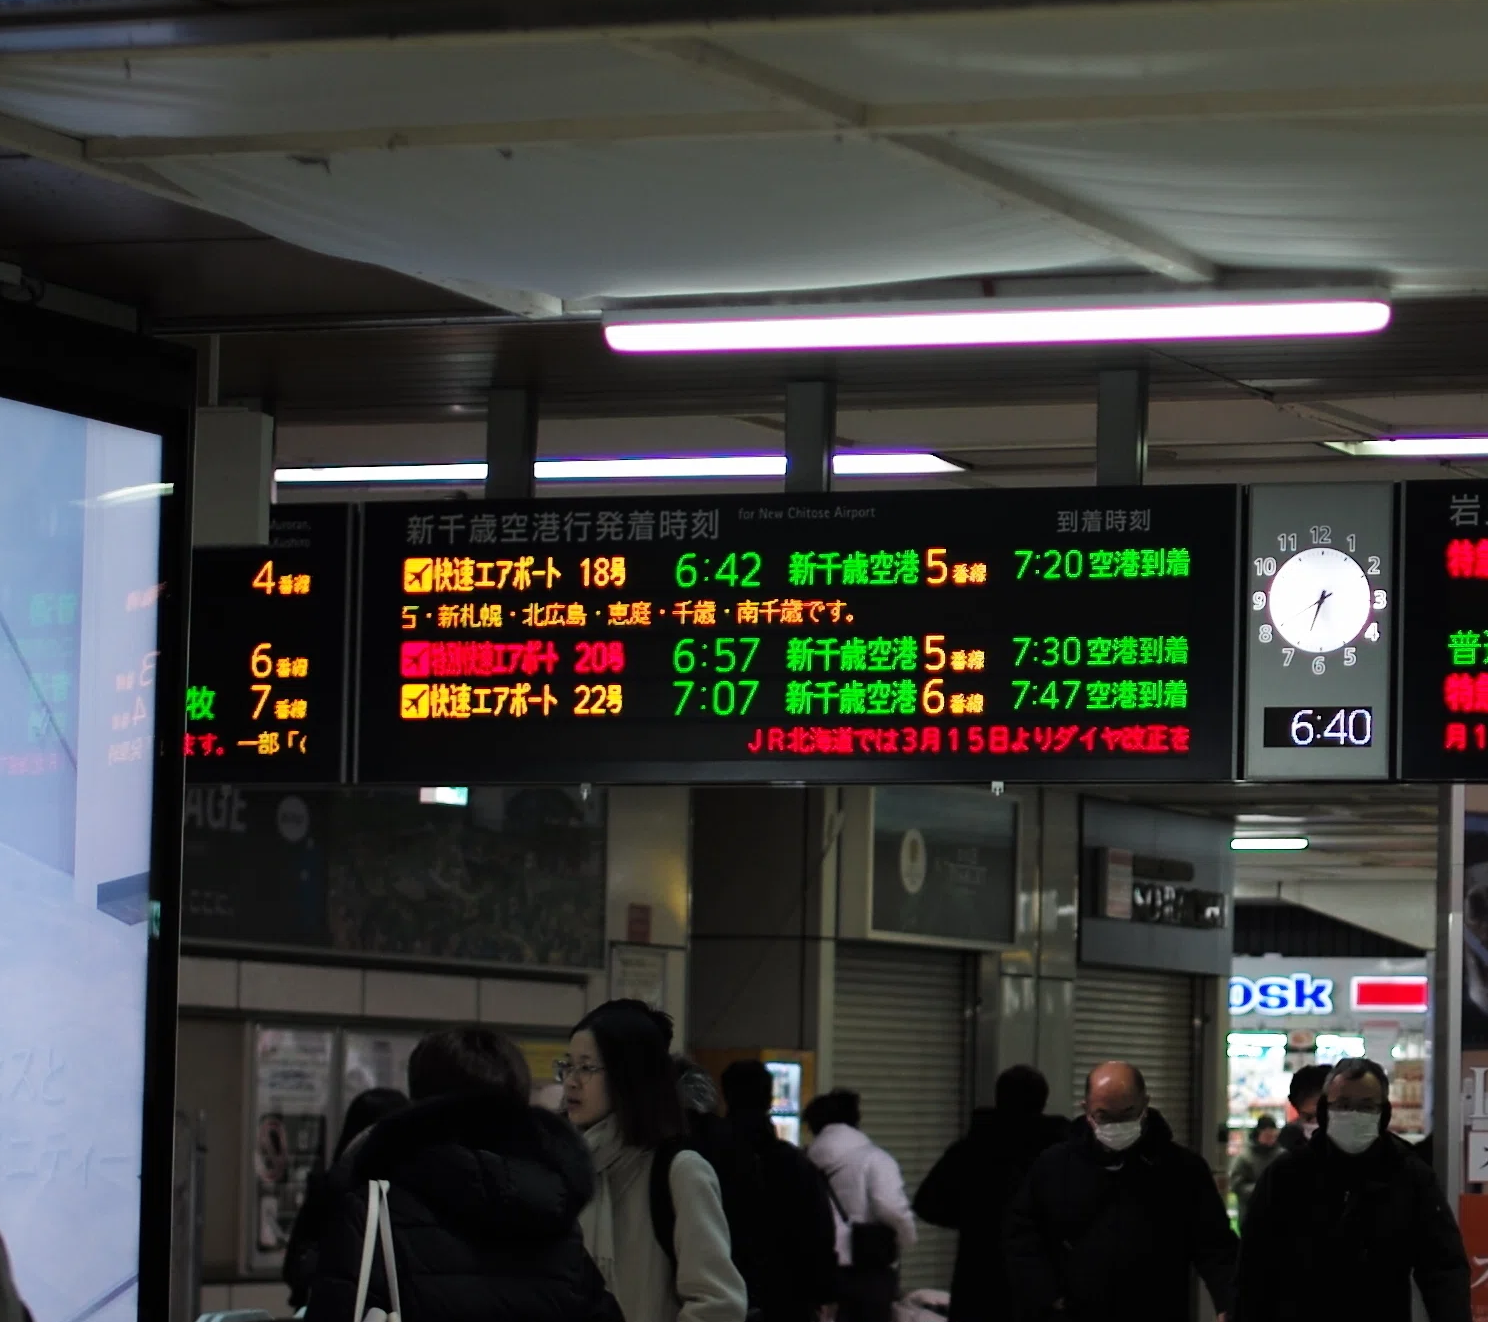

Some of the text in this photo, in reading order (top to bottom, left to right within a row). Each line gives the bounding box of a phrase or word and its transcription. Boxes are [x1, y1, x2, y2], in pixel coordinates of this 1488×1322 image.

[738, 505, 876, 522] for New Chitose Airport
[1055, 509, 1152, 534] 到着時刻
[406, 508, 721, 546] 新千歳空港行発着時刻
[1309, 526, 1332, 545] 12
[1277, 533, 1298, 552] 11
[1346, 534, 1357, 552] 1
[426, 556, 561, 593] 快速エアポート
[580, 556, 625, 588] 18号
[676, 552, 761, 587] 6:42
[789, 549, 919, 585] 新千歳空港
[1015, 550, 1082, 579] 7:20
[1089, 548, 1190, 578] 空港到着
[1253, 557, 1276, 576] 10
[1366, 557, 1381, 575] 2
[1252, 591, 1266, 610] 9
[1372, 591, 1388, 610] 3
[1258, 625, 1272, 643] 8
[1364, 622, 1381, 643] 4
[574, 641, 625, 673] 20号
[673, 638, 760, 673] 6:57
[787, 636, 918, 671] 新千歳空港
[1013, 637, 1080, 666] 7:30
[1087, 636, 1188, 665] 空港到着
[1281, 649, 1295, 667] 7
[1343, 647, 1357, 667] 5
[1311, 656, 1326, 675] 6
[423, 683, 558, 719] 快速エアポート
[574, 685, 622, 716] 22号
[673, 681, 759, 715] 7:07
[786, 679, 917, 714] 新千歳空港
[1012, 681, 1081, 709] 7:47
[1087, 680, 1187, 709] 空港到着
[1289, 709, 1372, 747] 6:40
